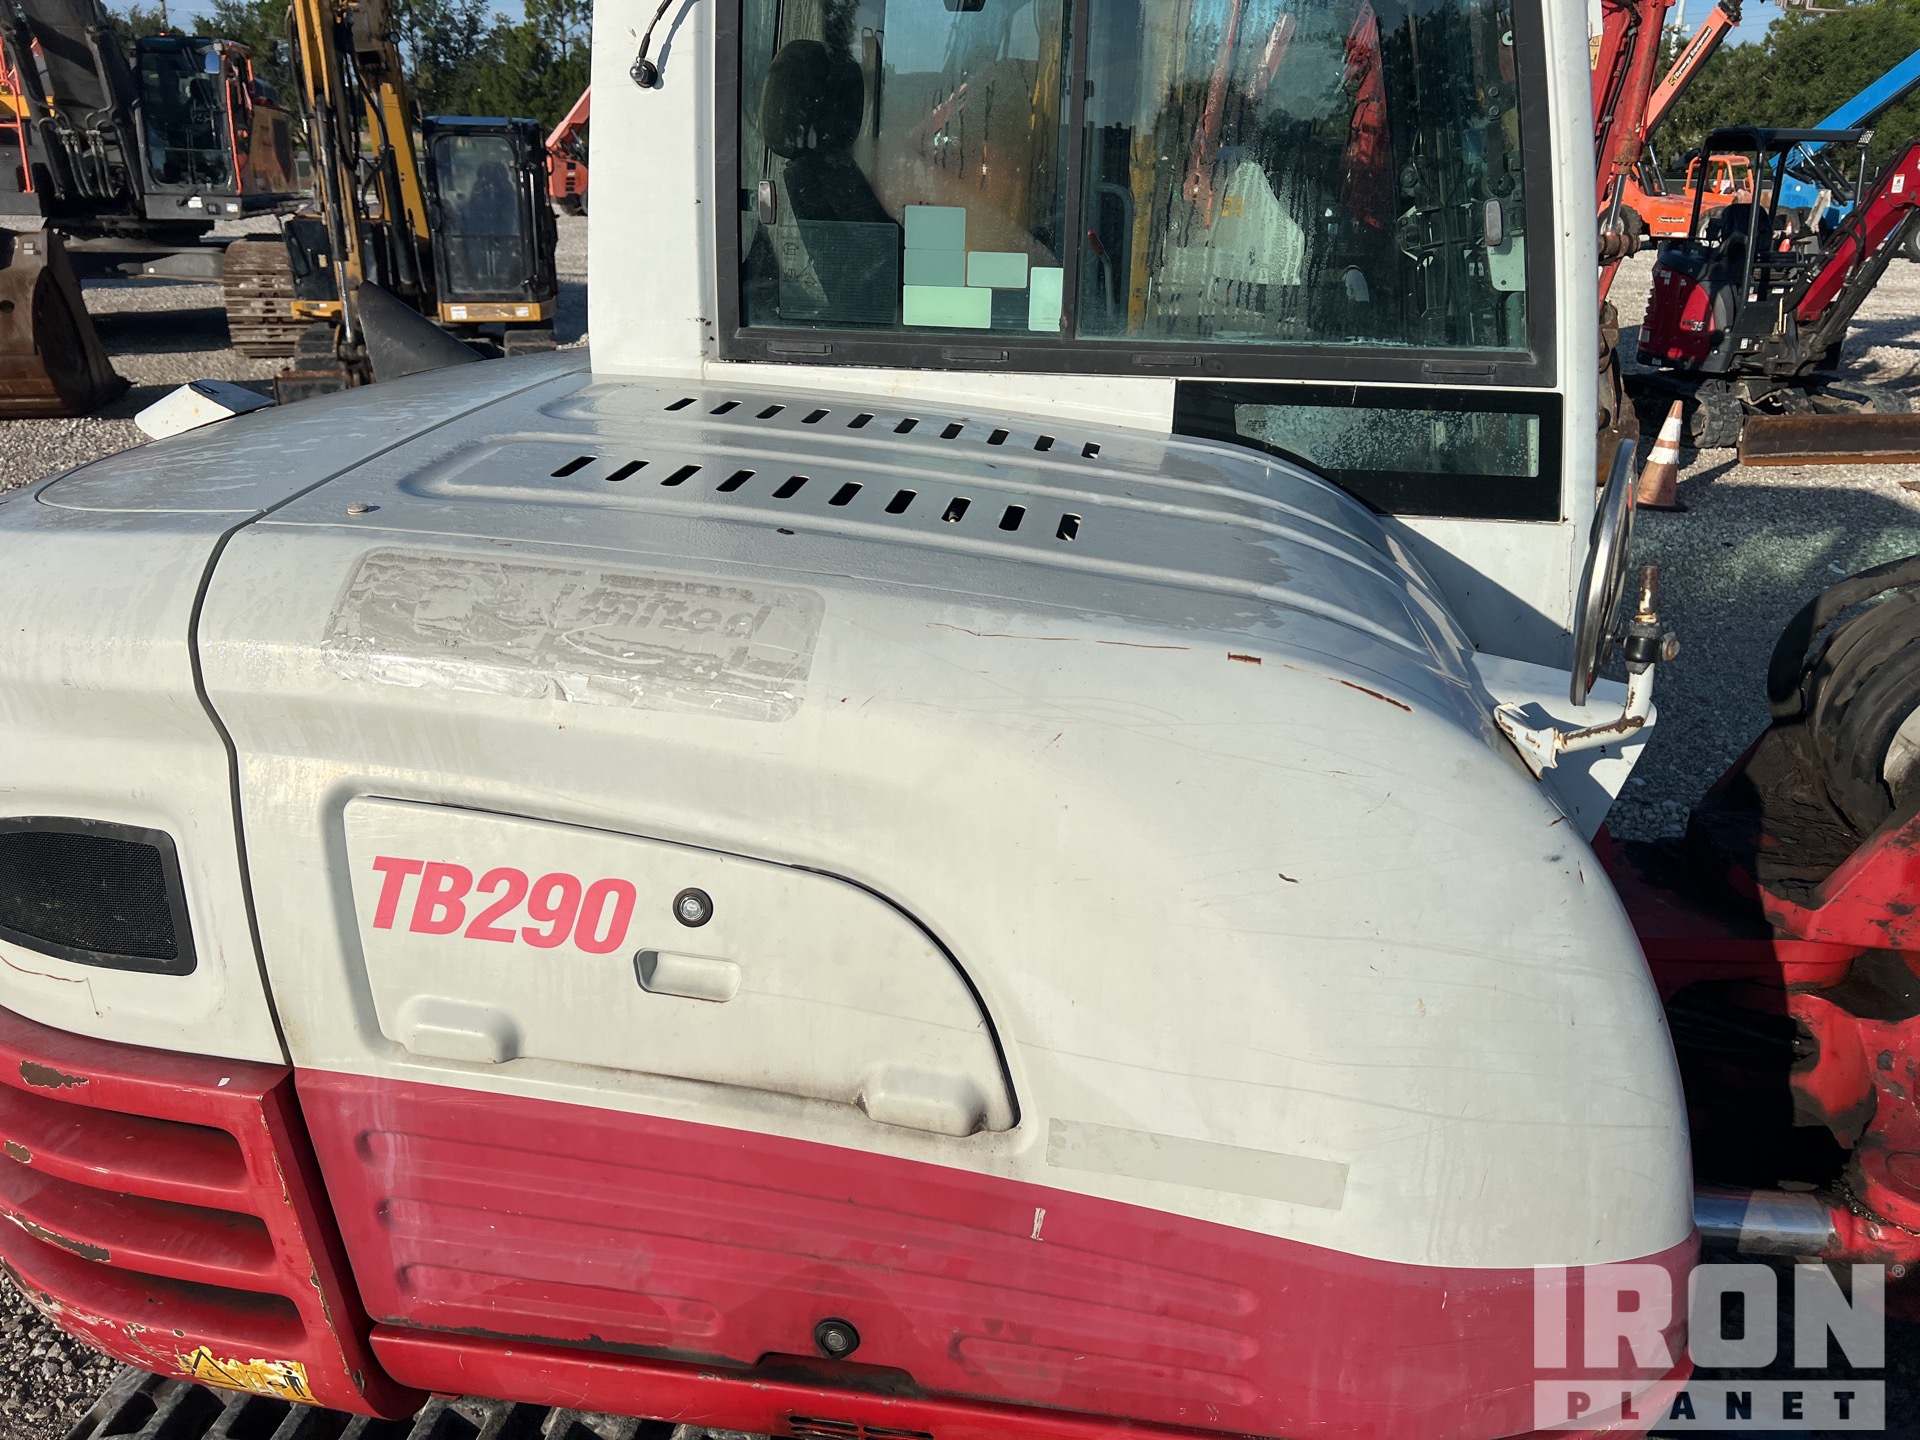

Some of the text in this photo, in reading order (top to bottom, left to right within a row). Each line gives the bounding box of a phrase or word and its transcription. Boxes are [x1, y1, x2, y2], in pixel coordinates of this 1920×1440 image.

[1675, 27, 1712, 77] Synergy Equipment
[372, 855, 637, 954] TB290
